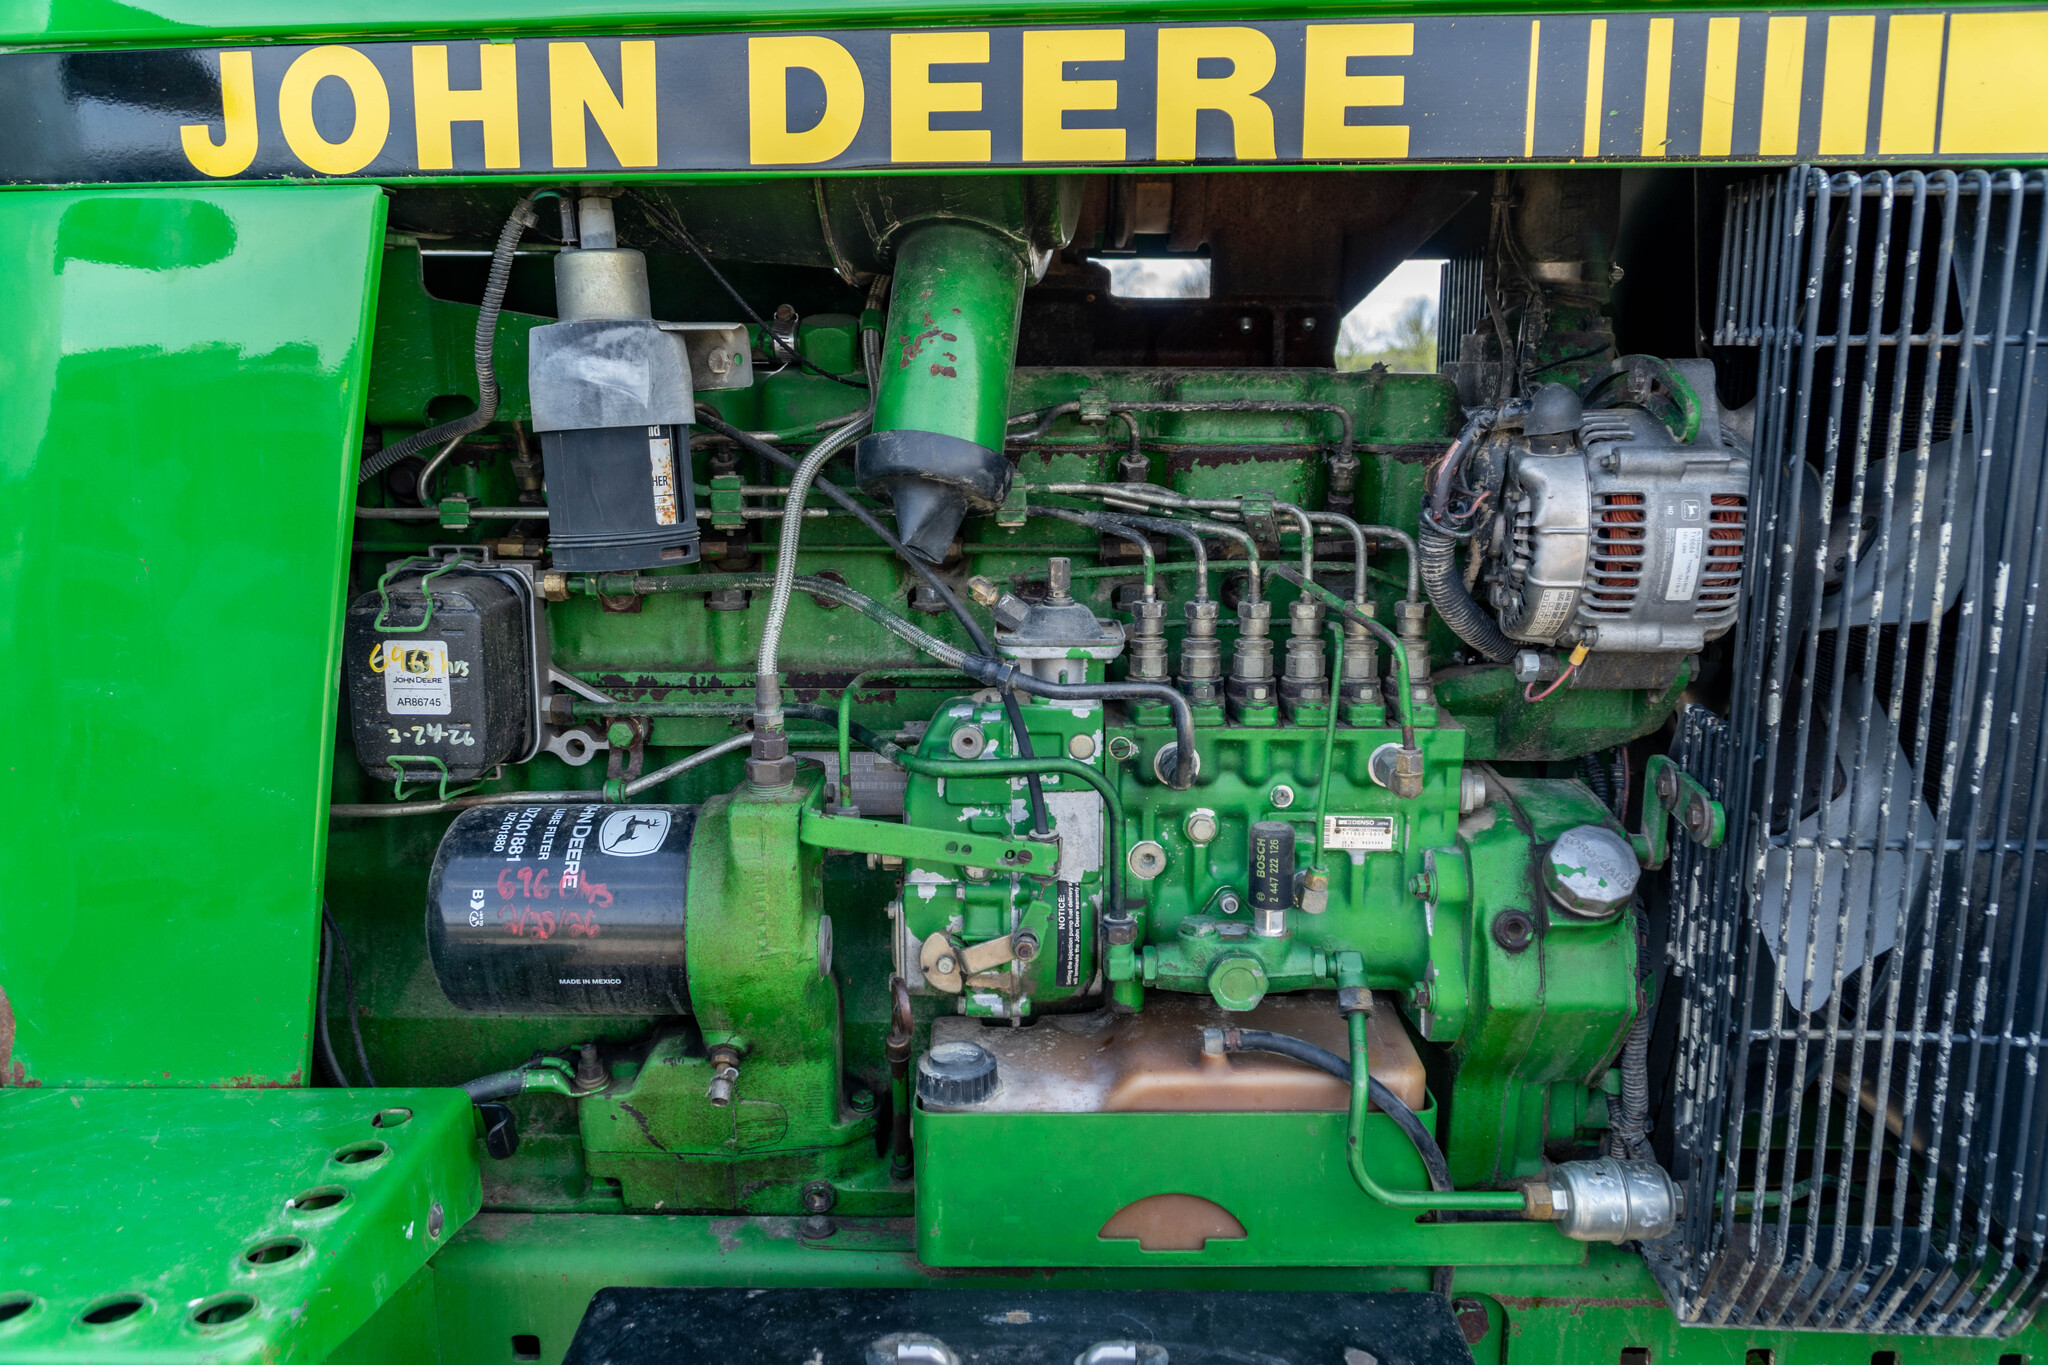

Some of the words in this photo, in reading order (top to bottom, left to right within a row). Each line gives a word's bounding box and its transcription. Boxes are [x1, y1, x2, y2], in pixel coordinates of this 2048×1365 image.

[180, 40, 658, 177] JOHN
[748, 22, 1415, 165] DEERE
[653, 475, 668, 487] HER
[393, 676, 415, 684] JOHN
[416, 675, 442, 684] DEERE
[397, 697, 441, 706] AR86745
[548, 808, 567, 825] LUBE
[576, 804, 601, 823] OHN
[493, 812, 518, 852] DZ101880
[506, 807, 542, 862] DZ101881
[538, 826, 558, 861] FILTER
[1270, 839, 1279, 854] 126
[561, 825, 593, 889] DEERE
[1256, 838, 1266, 878] BOSCH
[1270, 858, 1279, 874] 222
[1270, 877, 1279, 894] 447
[1058, 894, 1066, 930] NOTICE:
